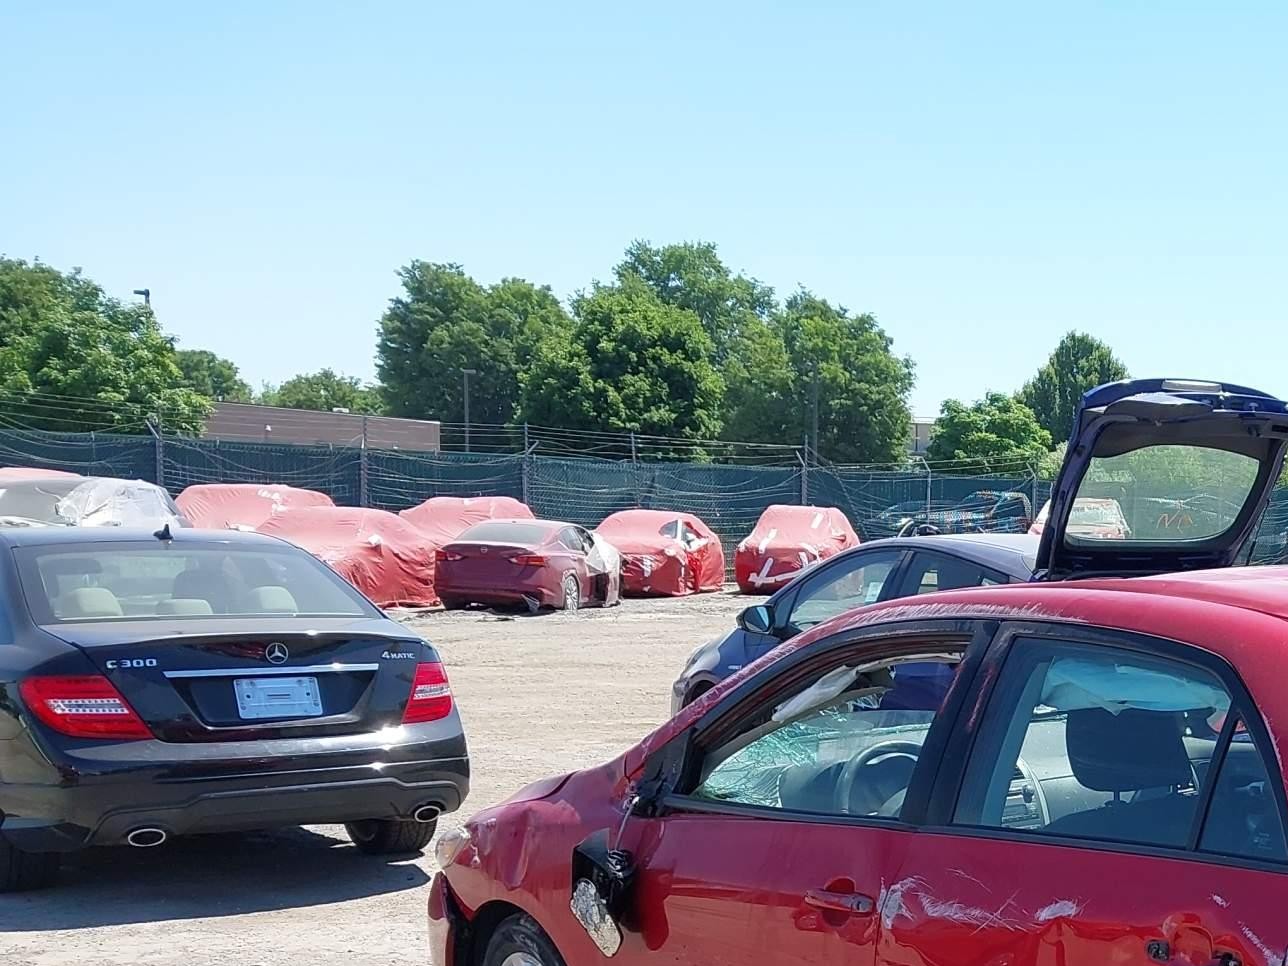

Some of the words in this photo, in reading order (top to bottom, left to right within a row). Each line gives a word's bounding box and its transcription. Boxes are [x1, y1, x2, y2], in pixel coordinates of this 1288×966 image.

[381, 650, 416, 660] 4MATIC
[105, 659, 119, 669] C
[120, 658, 158, 668] 300
